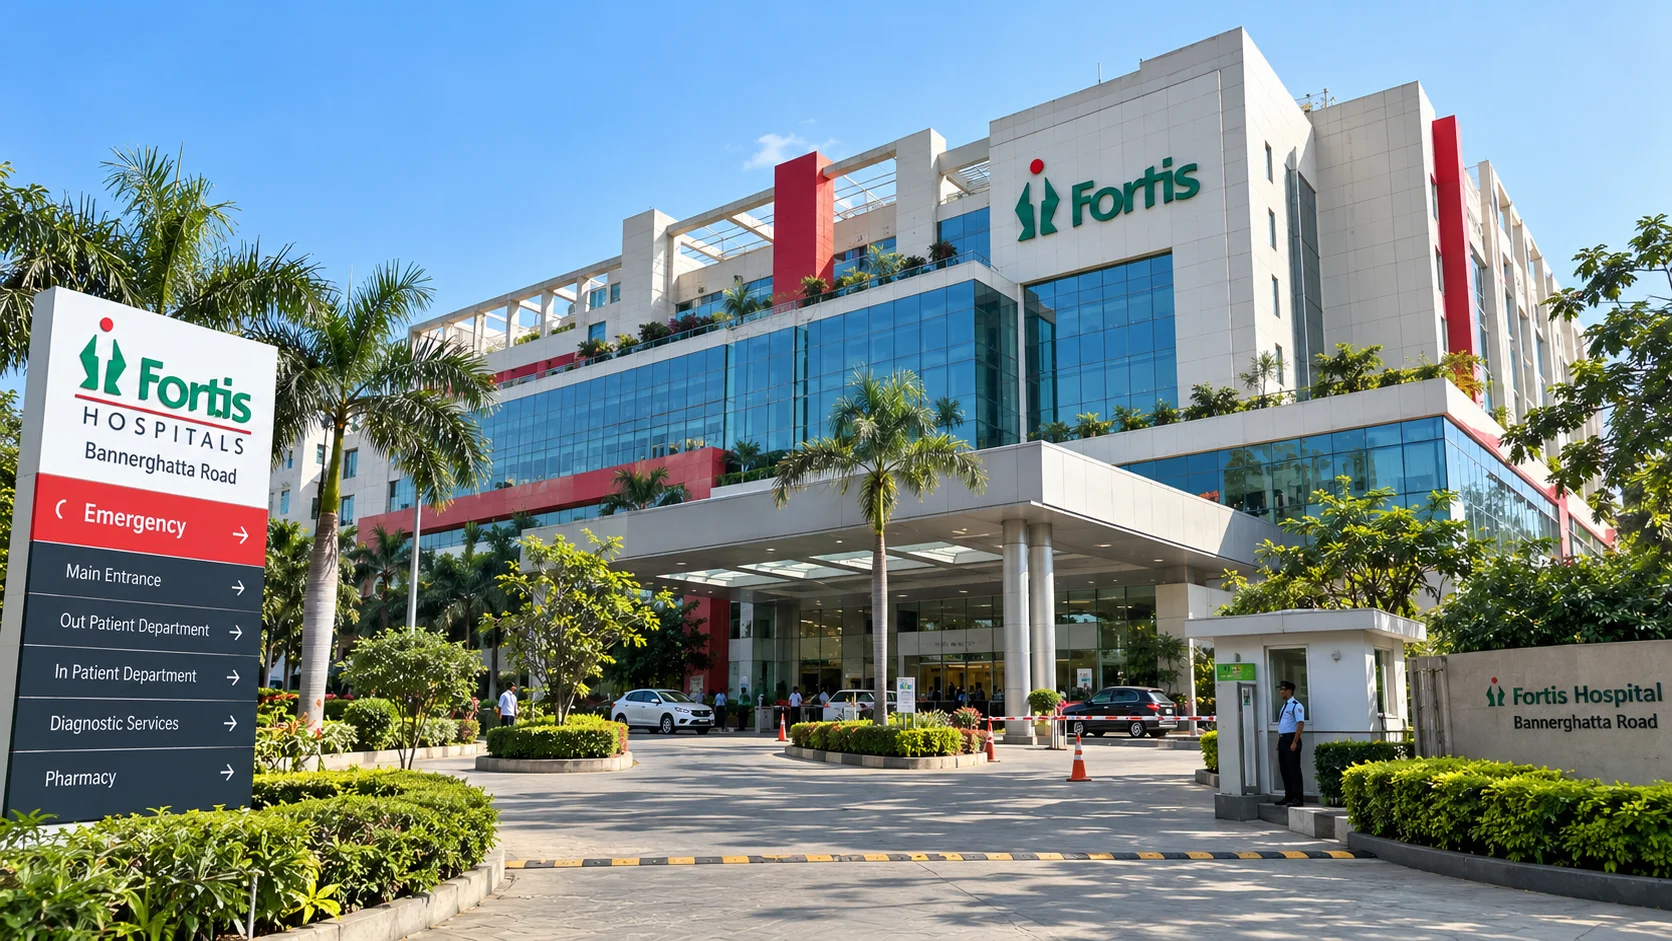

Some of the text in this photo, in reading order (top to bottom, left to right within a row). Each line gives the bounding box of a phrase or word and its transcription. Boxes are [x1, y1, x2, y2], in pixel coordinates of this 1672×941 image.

[1072, 157, 1201, 228] Fortis
[138, 356, 252, 424] Fortis
[83, 406, 245, 455] HOSPITALS
[84, 441, 237, 485] Bannerghatta Road
[84, 503, 187, 539] Emergency
[66, 563, 162, 588] Main Entrance
[60, 612, 210, 638] Out Patient Department
[54, 663, 197, 684] In Patient Department
[1513, 682, 1663, 708] Fortis Hospital
[50, 715, 179, 734] Diagnostic Services
[1514, 713, 1658, 732] Bannerghatta Road
[45, 770, 117, 788] Pharmacy
